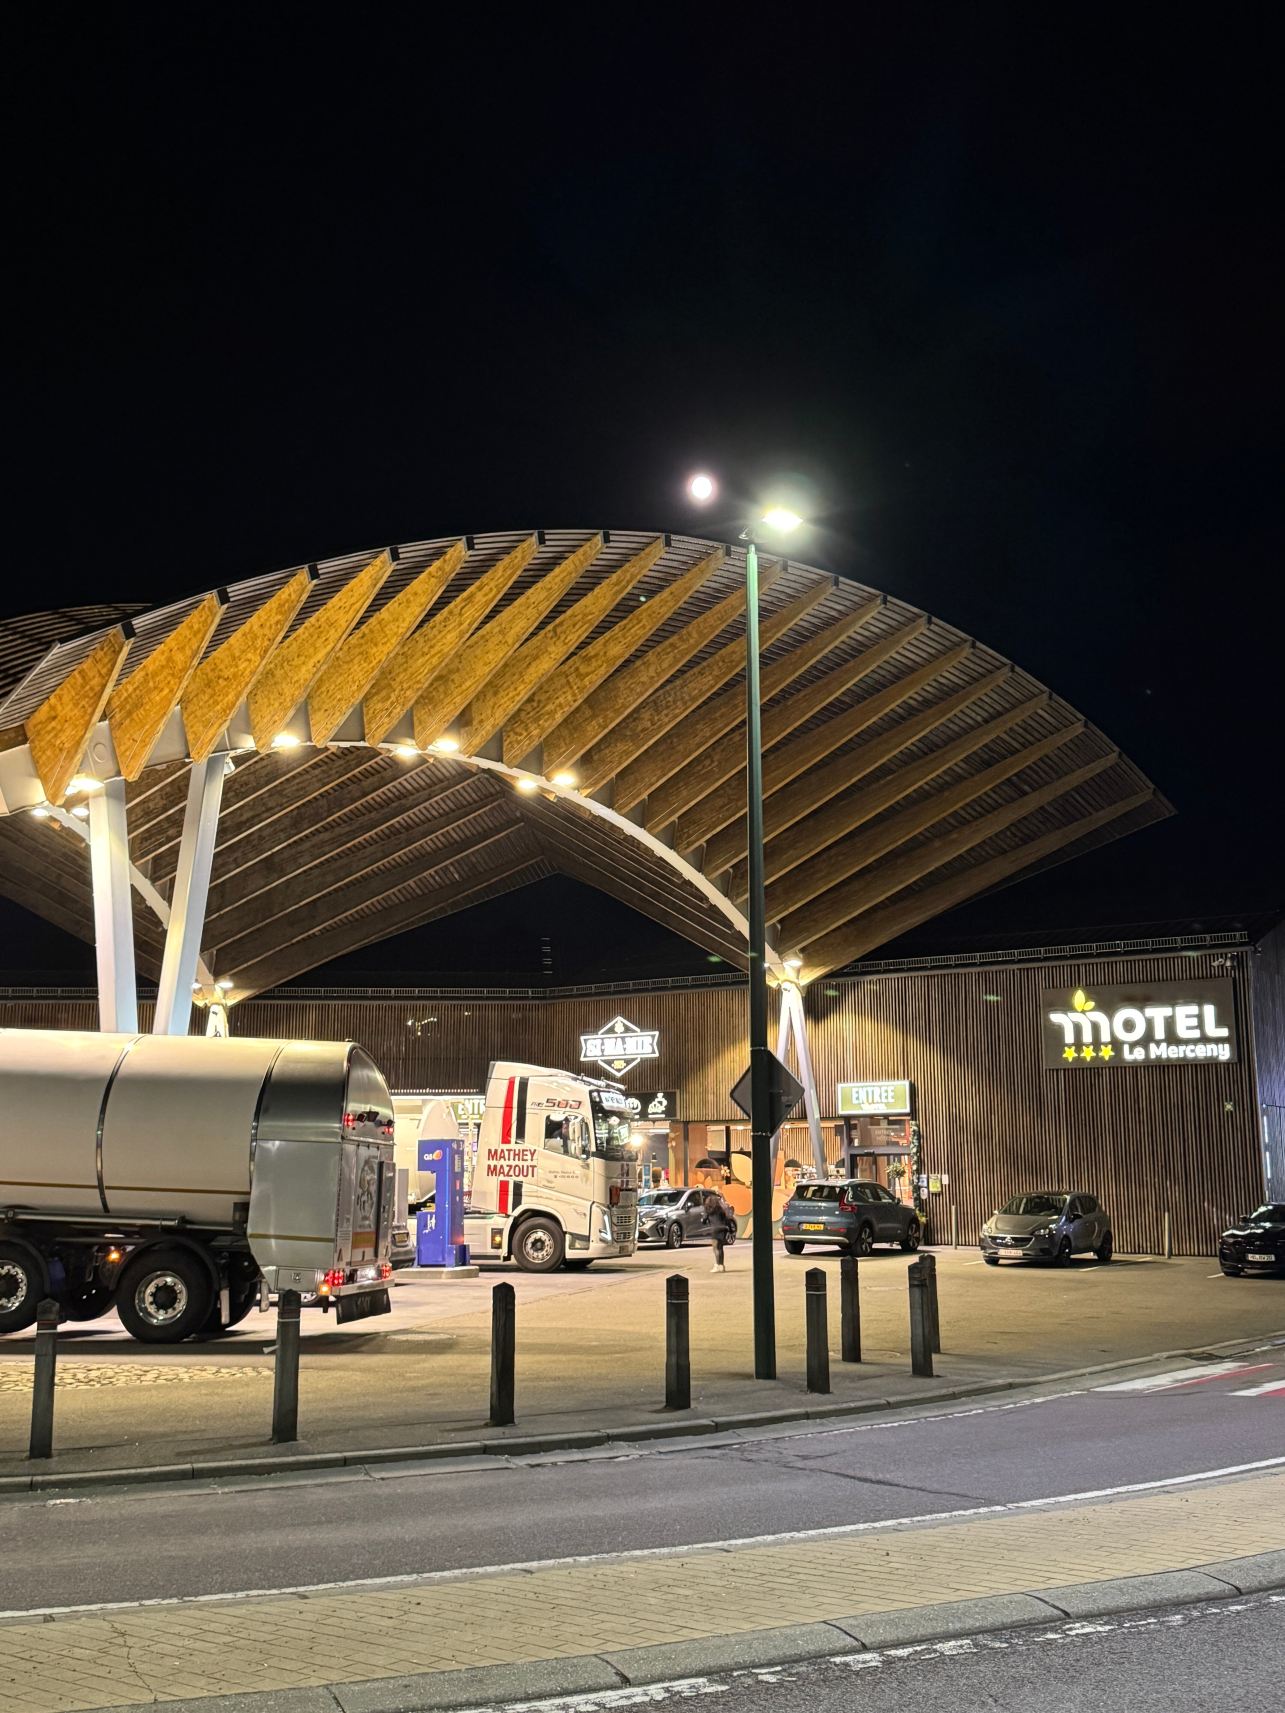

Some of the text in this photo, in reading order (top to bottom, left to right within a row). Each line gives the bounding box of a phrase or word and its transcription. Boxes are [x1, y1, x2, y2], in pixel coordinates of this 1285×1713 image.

[1123, 1041, 1230, 1060] Le Merceny
[487, 1148, 537, 1161] MATHEY
[486, 1164, 537, 1178] MAZOUT
